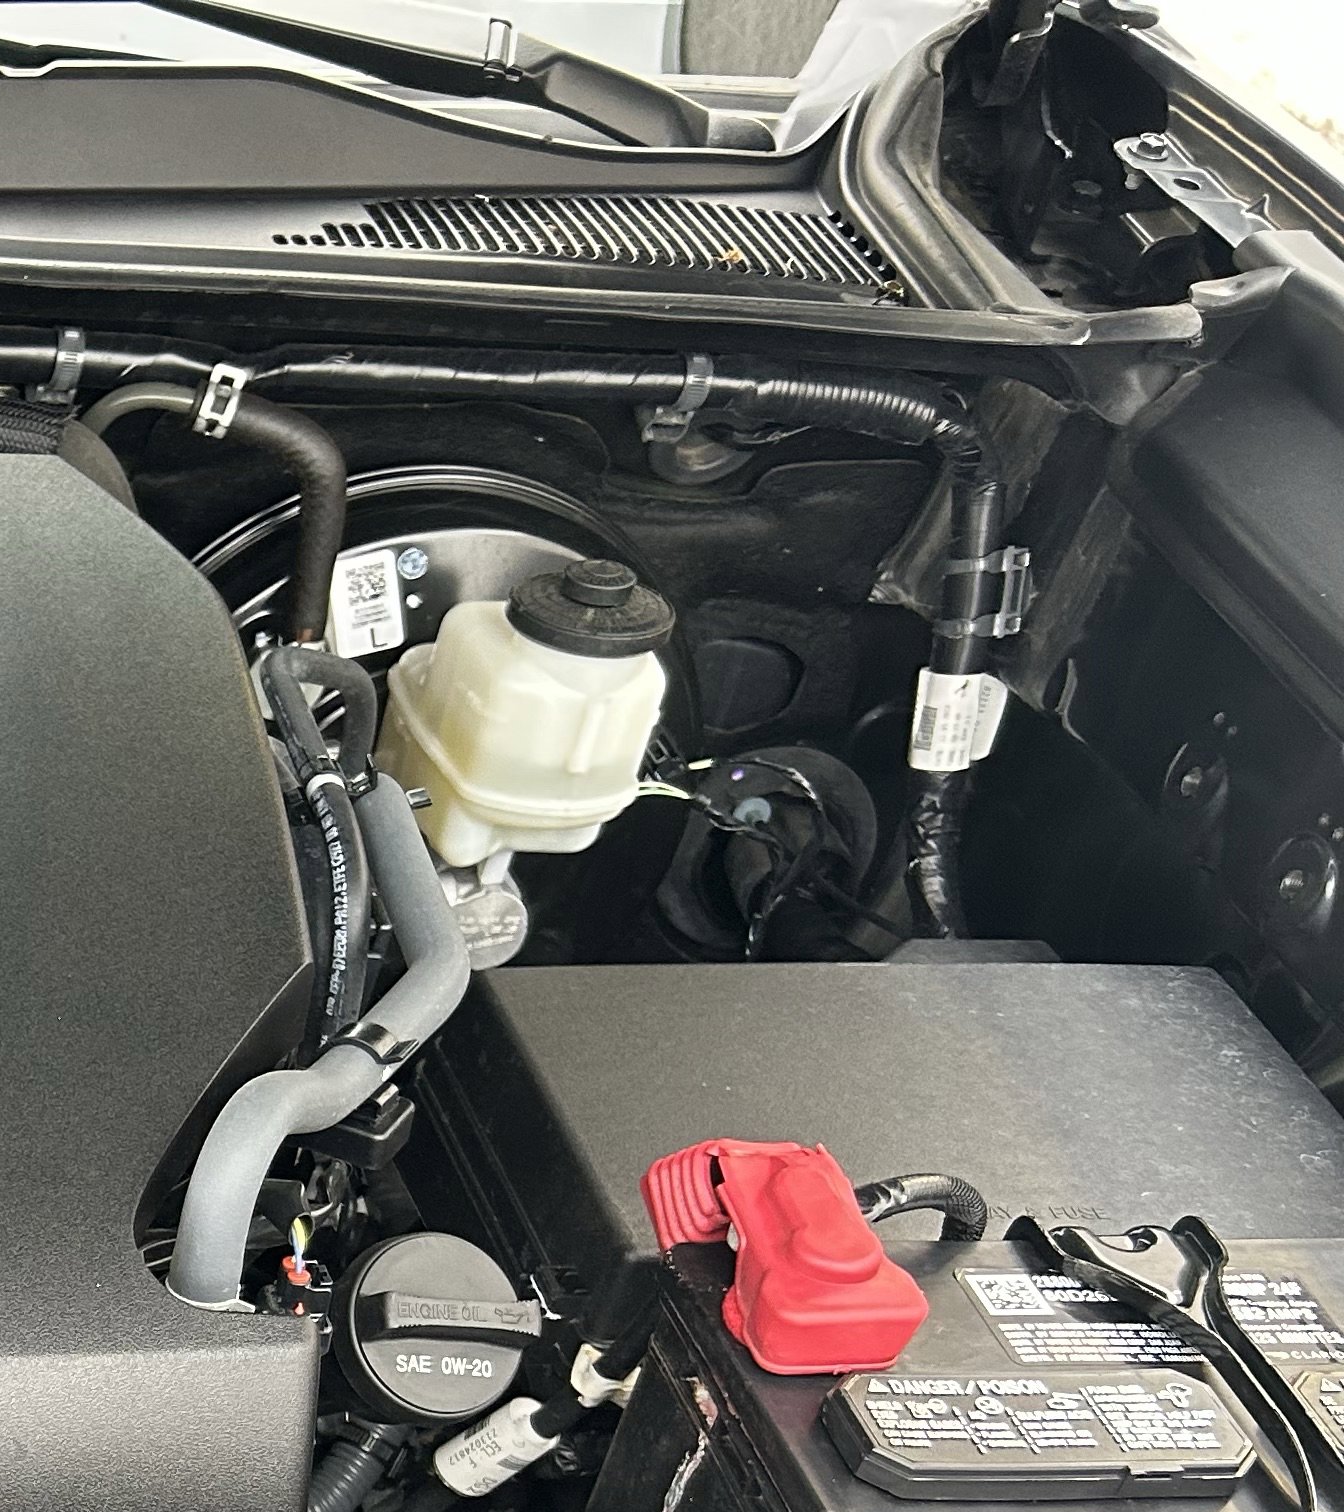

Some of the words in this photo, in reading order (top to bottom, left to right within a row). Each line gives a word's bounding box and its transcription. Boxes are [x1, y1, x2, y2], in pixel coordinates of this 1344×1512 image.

[370, 628, 388, 648] L
[1048, 1205, 1111, 1221] FUSE
[397, 1302, 458, 1321] ENGINE
[462, 1303, 488, 1322] OIL
[1290, 1350, 1344, 1361] CLARIO
[396, 1354, 432, 1374] SAE
[441, 1356, 493, 1378] 0W-20
